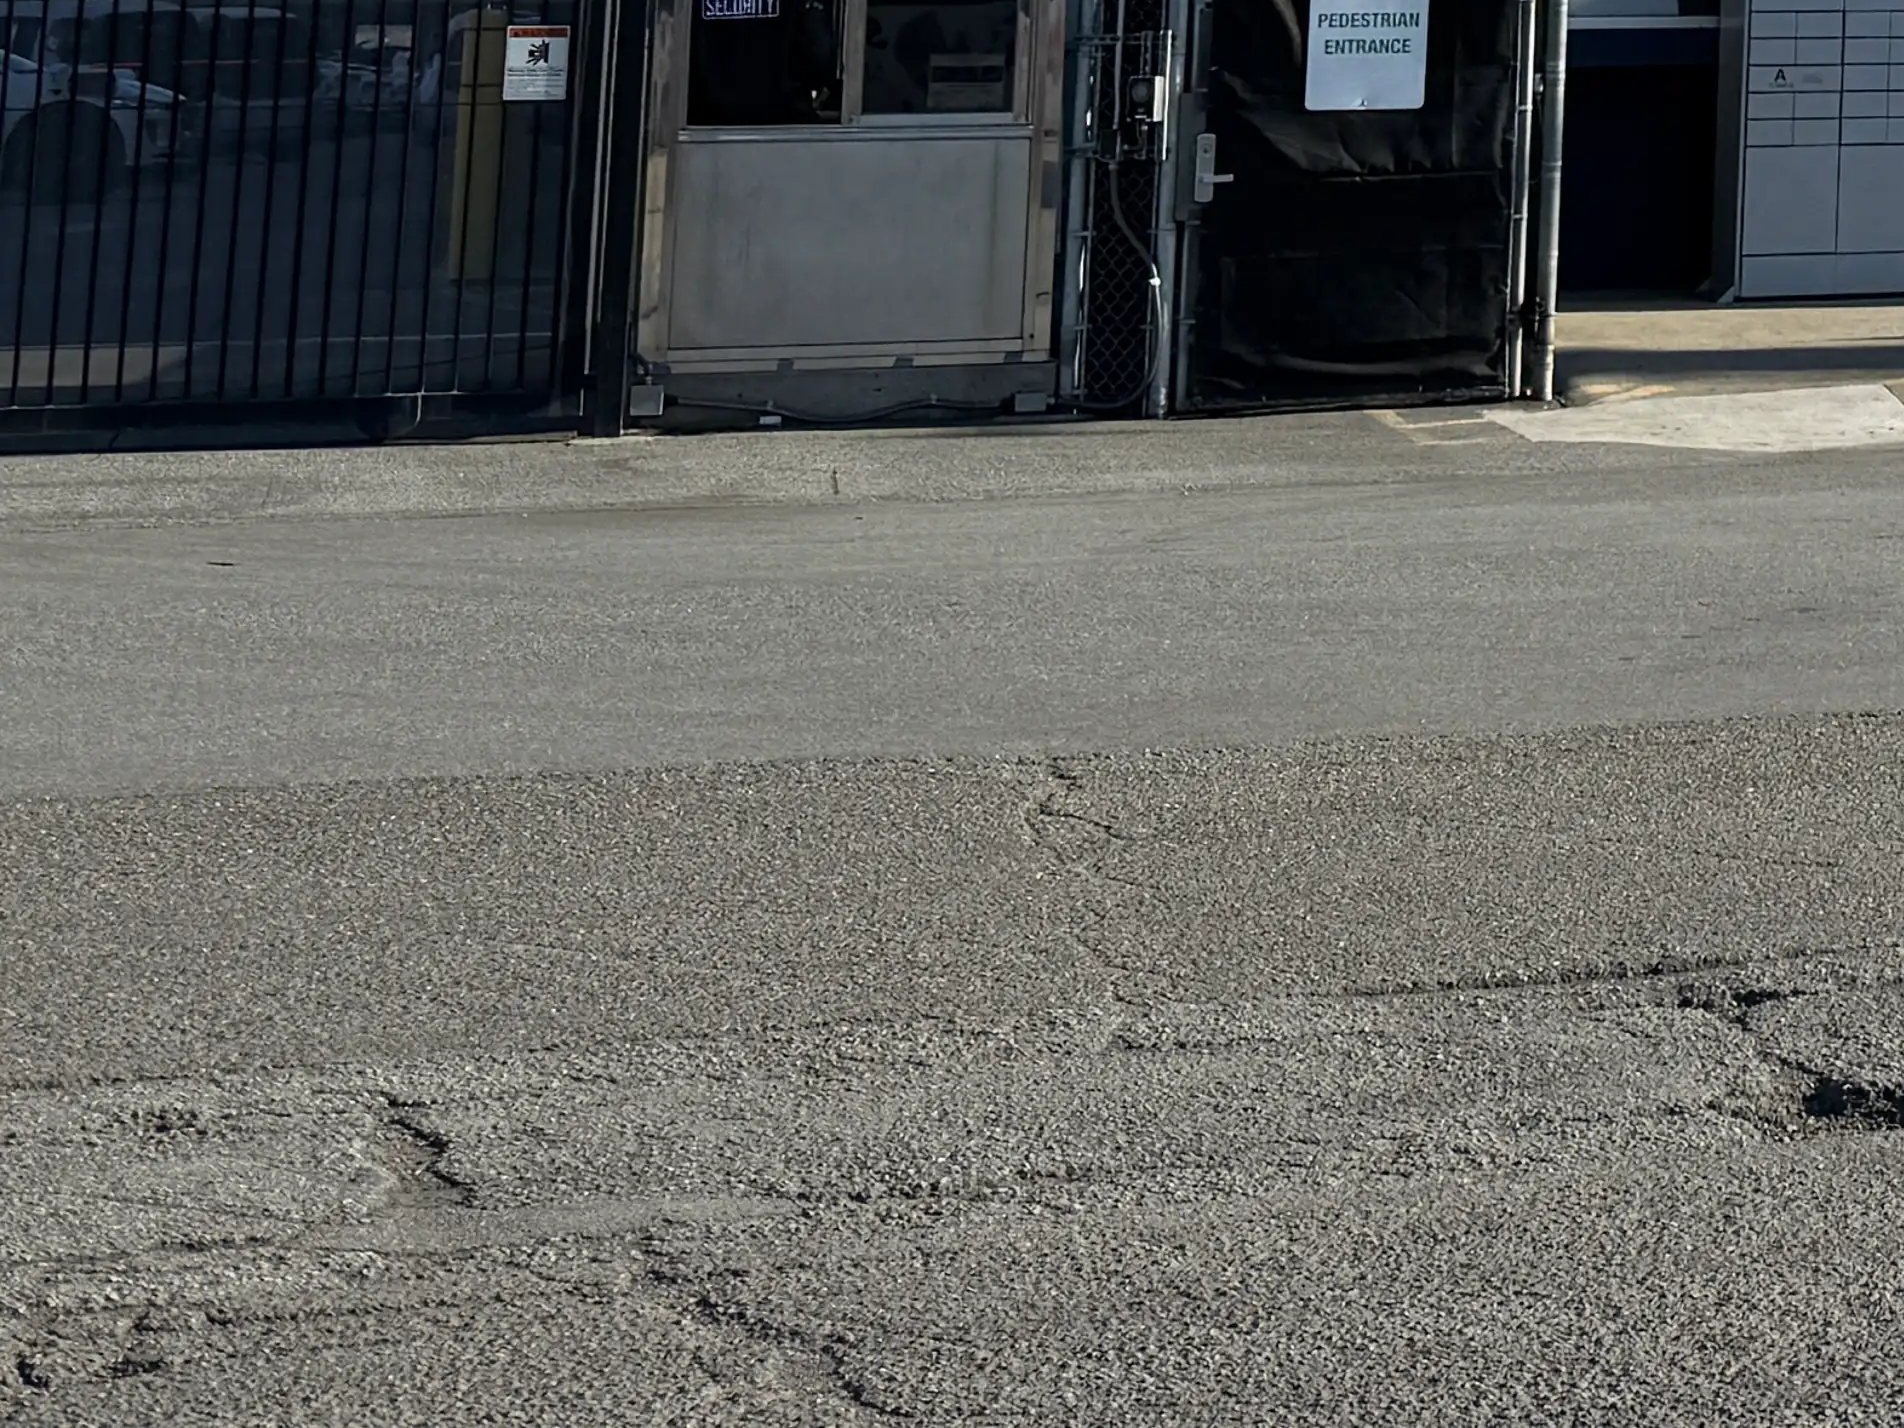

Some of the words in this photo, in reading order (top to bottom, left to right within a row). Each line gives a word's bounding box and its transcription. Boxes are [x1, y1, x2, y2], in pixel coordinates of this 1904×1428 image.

[1318, 12, 1420, 28] PEDESTRIAN
[1324, 39, 1412, 55] ENTRANCE
[1774, 68, 1787, 83] A
